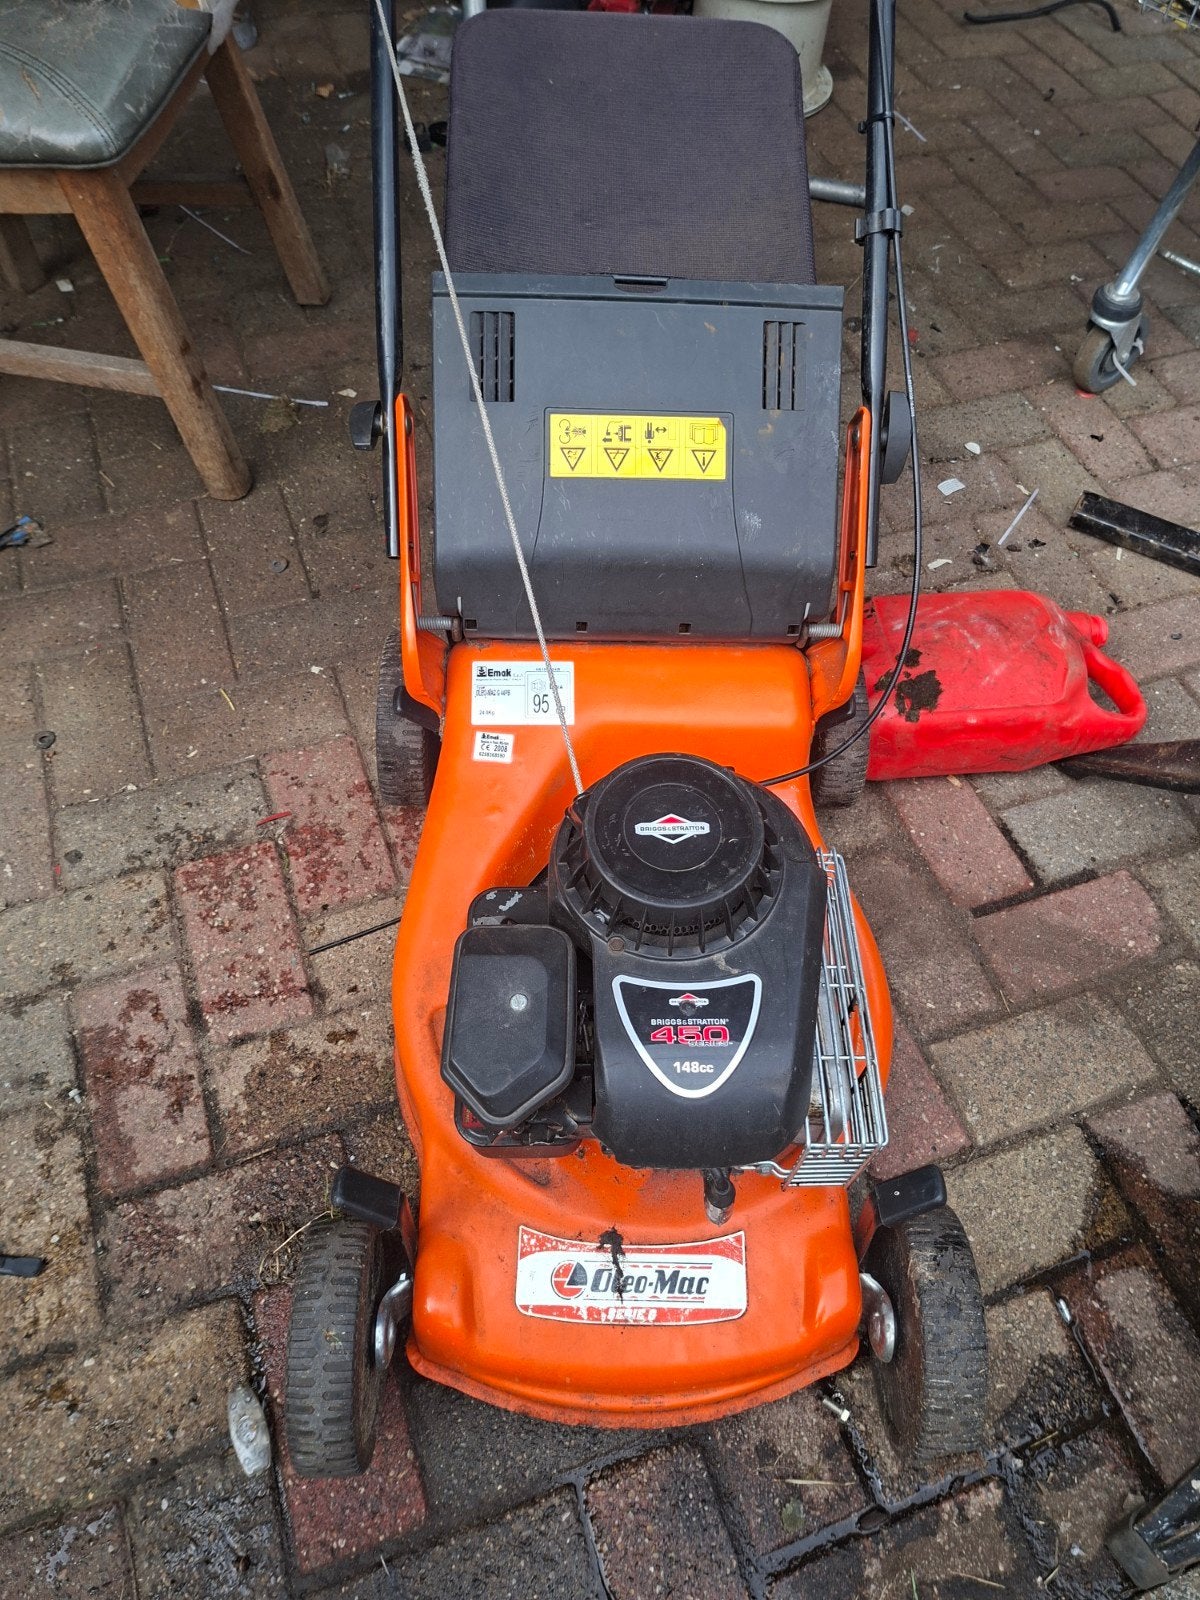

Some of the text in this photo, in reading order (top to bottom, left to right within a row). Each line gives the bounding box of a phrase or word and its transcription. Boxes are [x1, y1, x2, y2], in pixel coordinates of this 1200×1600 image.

[487, 669, 511, 677] Emak
[533, 694, 549, 713] 95
[650, 1026, 730, 1045] 450
[673, 1061, 715, 1074] 148cc
